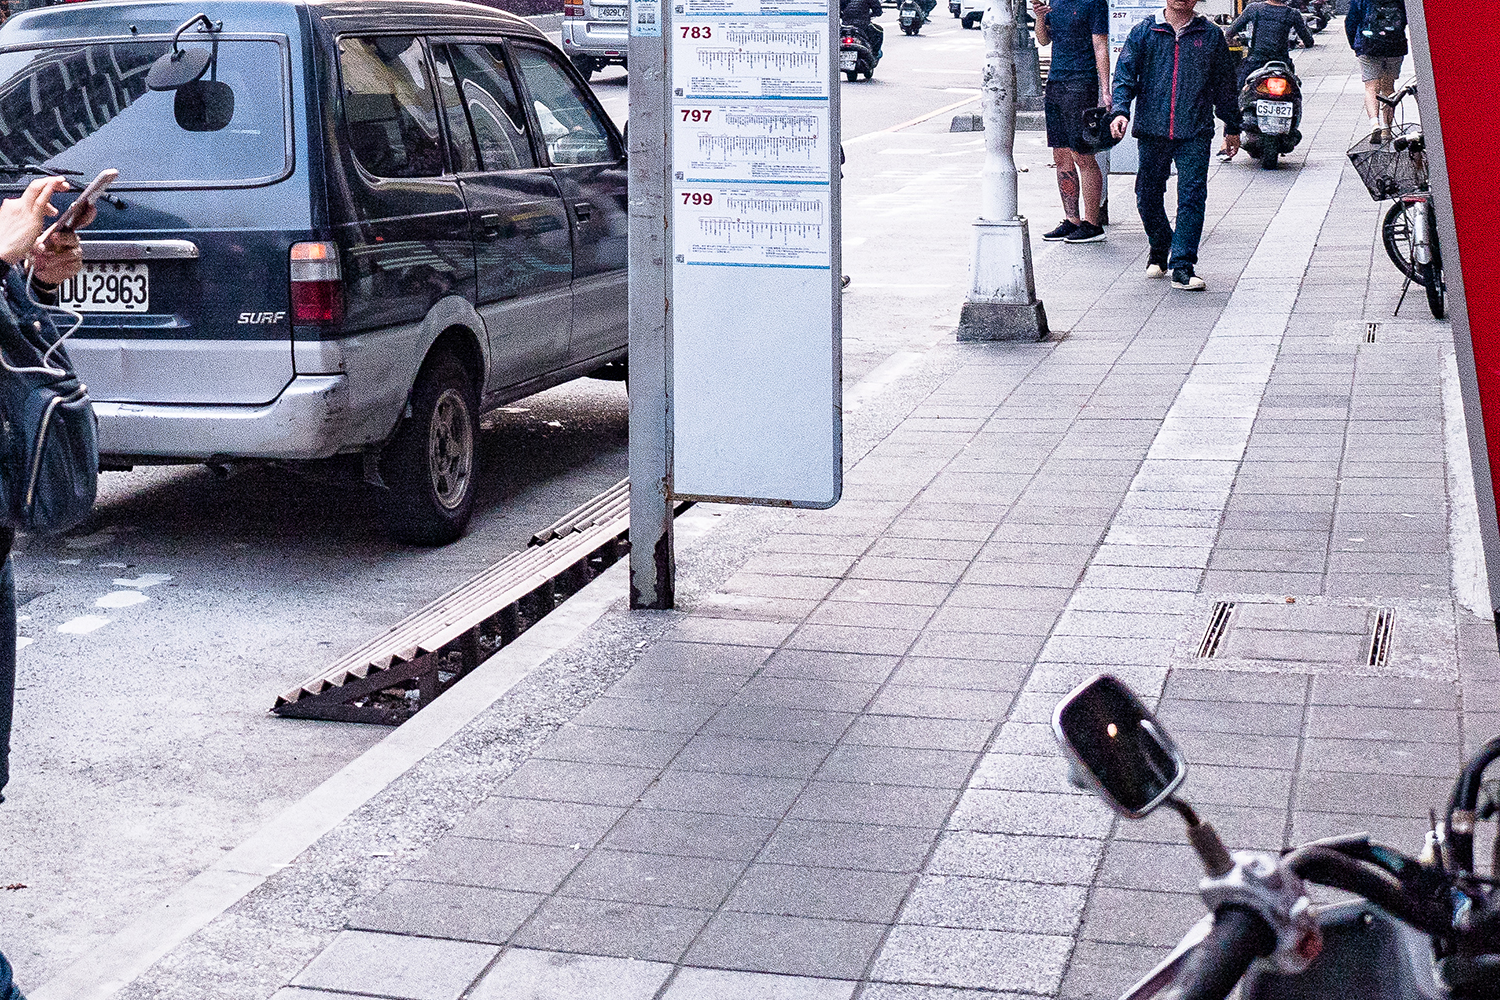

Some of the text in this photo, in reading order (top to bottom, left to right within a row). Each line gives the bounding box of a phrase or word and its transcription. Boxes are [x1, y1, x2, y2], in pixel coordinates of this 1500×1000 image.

[680, 26, 712, 39] 783
[680, 109, 712, 122] 797
[681, 193, 713, 205] 799
[237, 312, 286, 324] SURF
